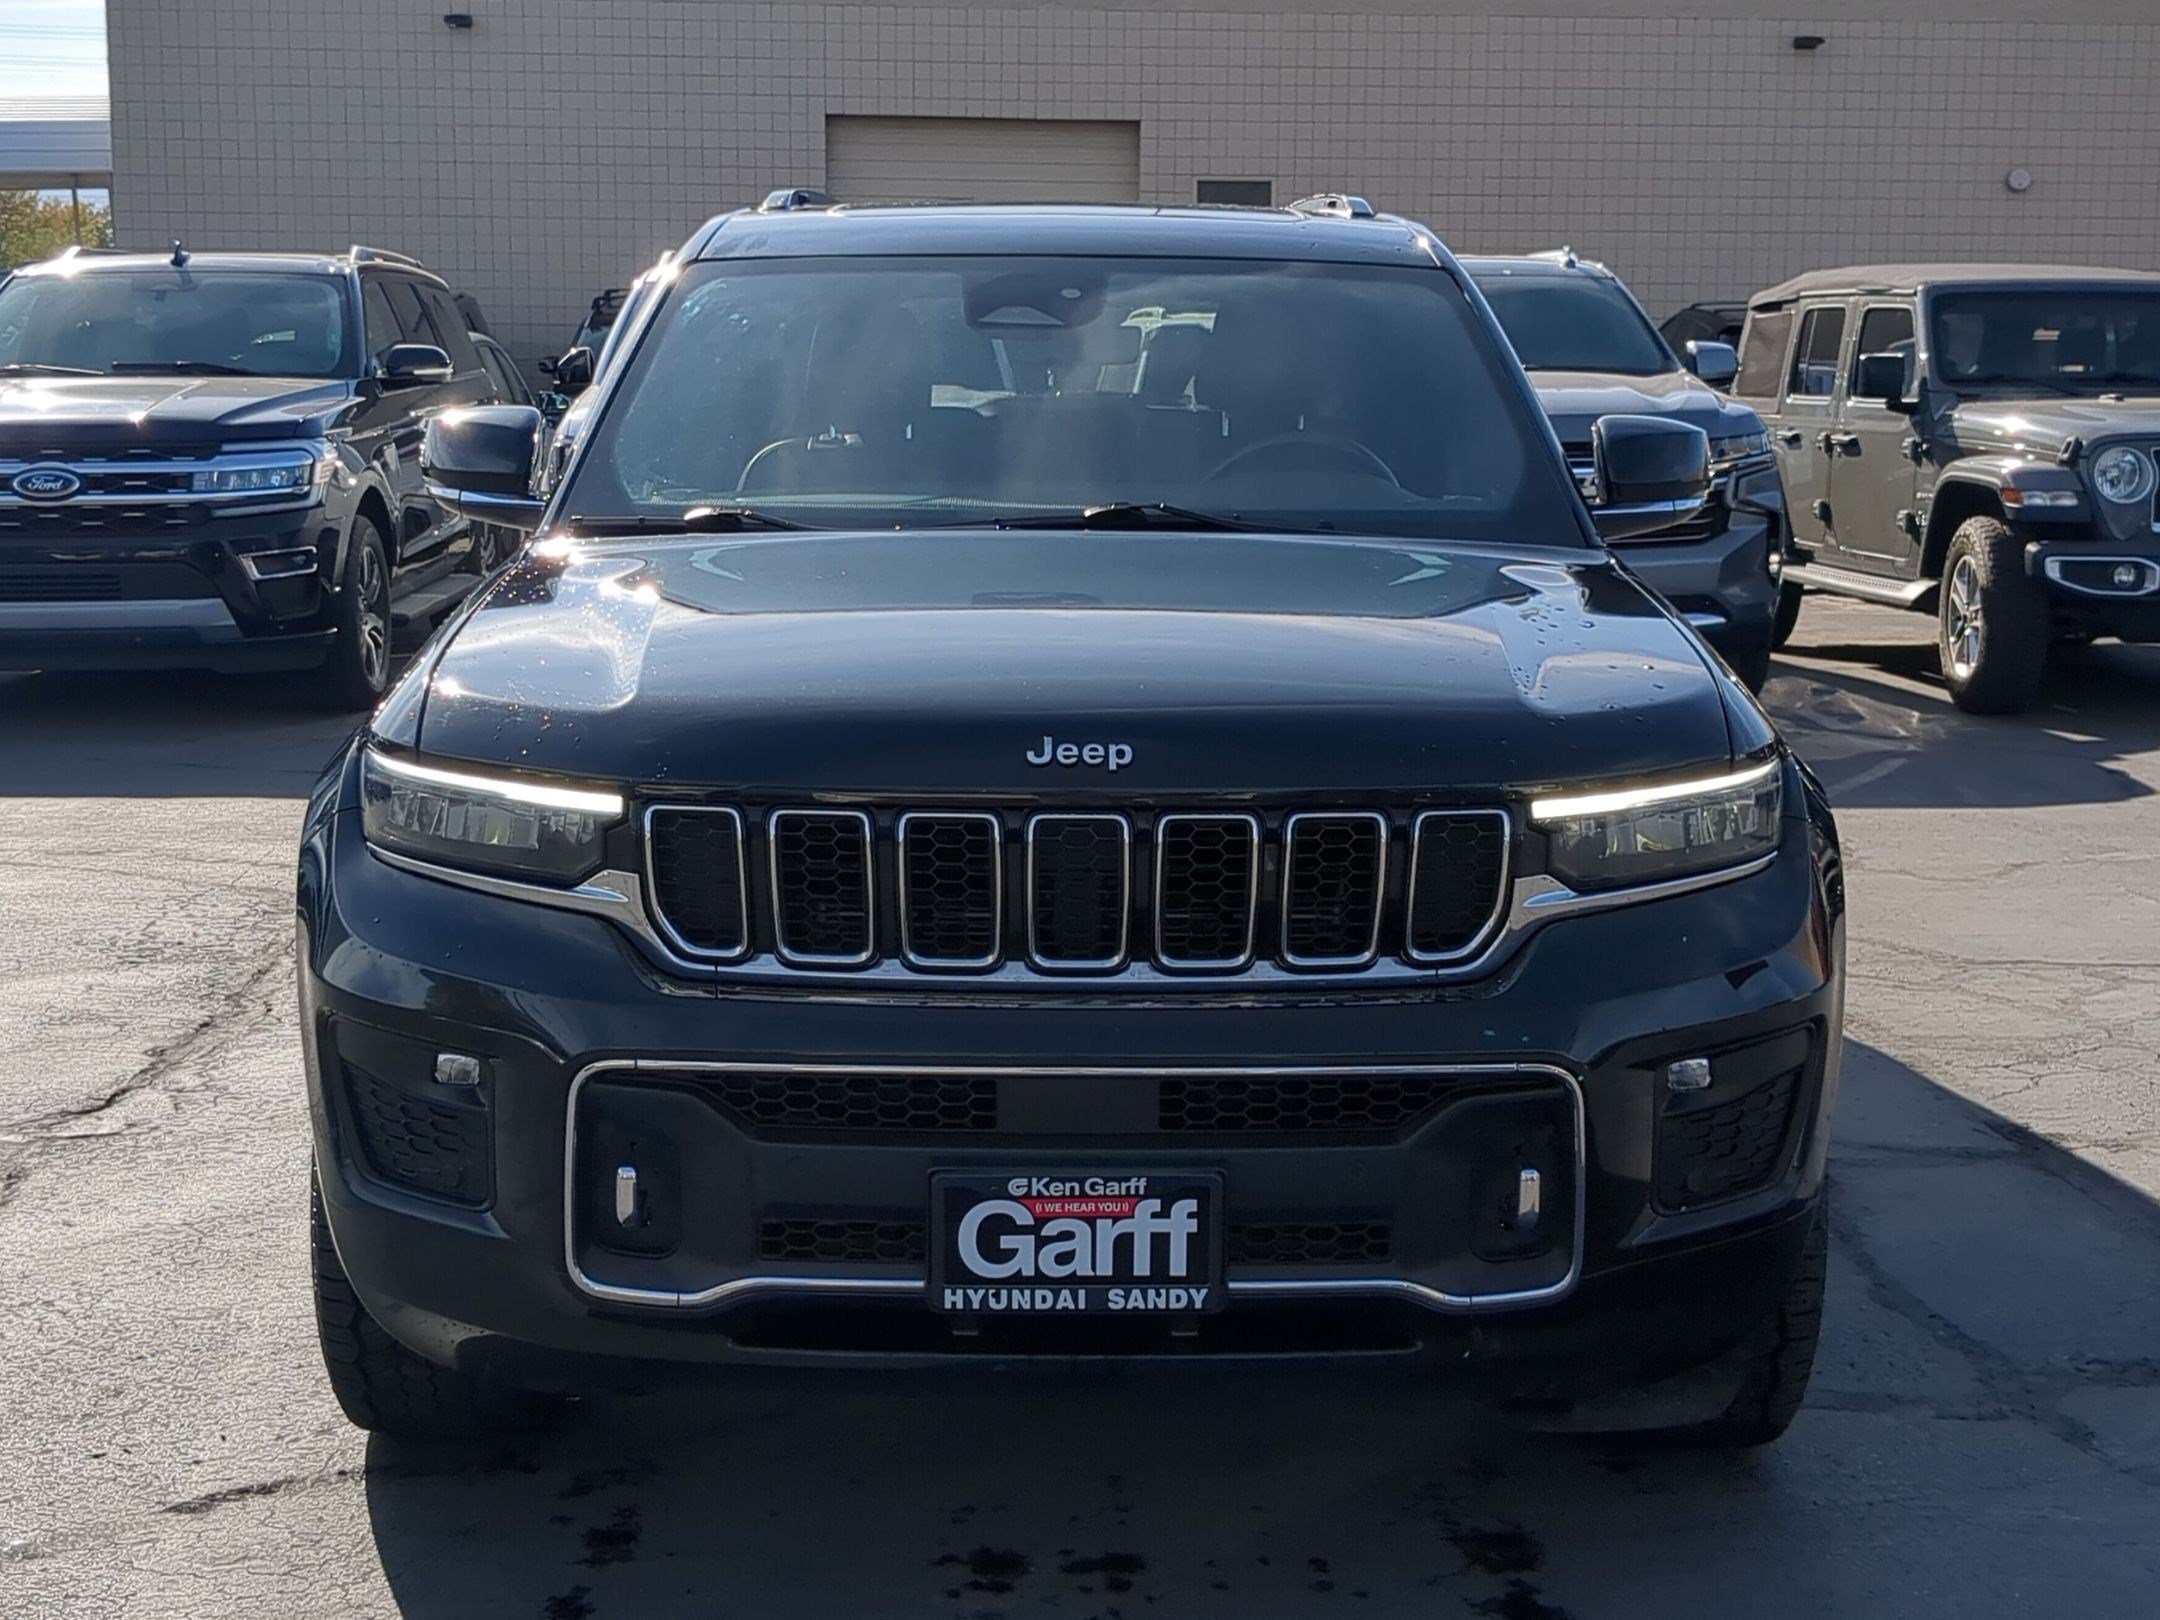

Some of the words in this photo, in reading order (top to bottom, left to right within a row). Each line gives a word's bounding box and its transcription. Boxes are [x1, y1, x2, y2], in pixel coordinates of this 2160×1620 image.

[28, 476, 64, 490] Ford
[1026, 736, 1133, 770] Jeep
[1031, 1177, 1080, 1196] Ken
[1084, 1177, 1147, 1196] Garff
[1044, 1202, 1062, 1212] WE
[1065, 1202, 1095, 1212] HEAR
[1098, 1202, 1121, 1212] YOU
[957, 1199, 1198, 1279] Garff
[944, 1288, 1086, 1310] HYUNDAI
[1107, 1288, 1208, 1310] SANDY
